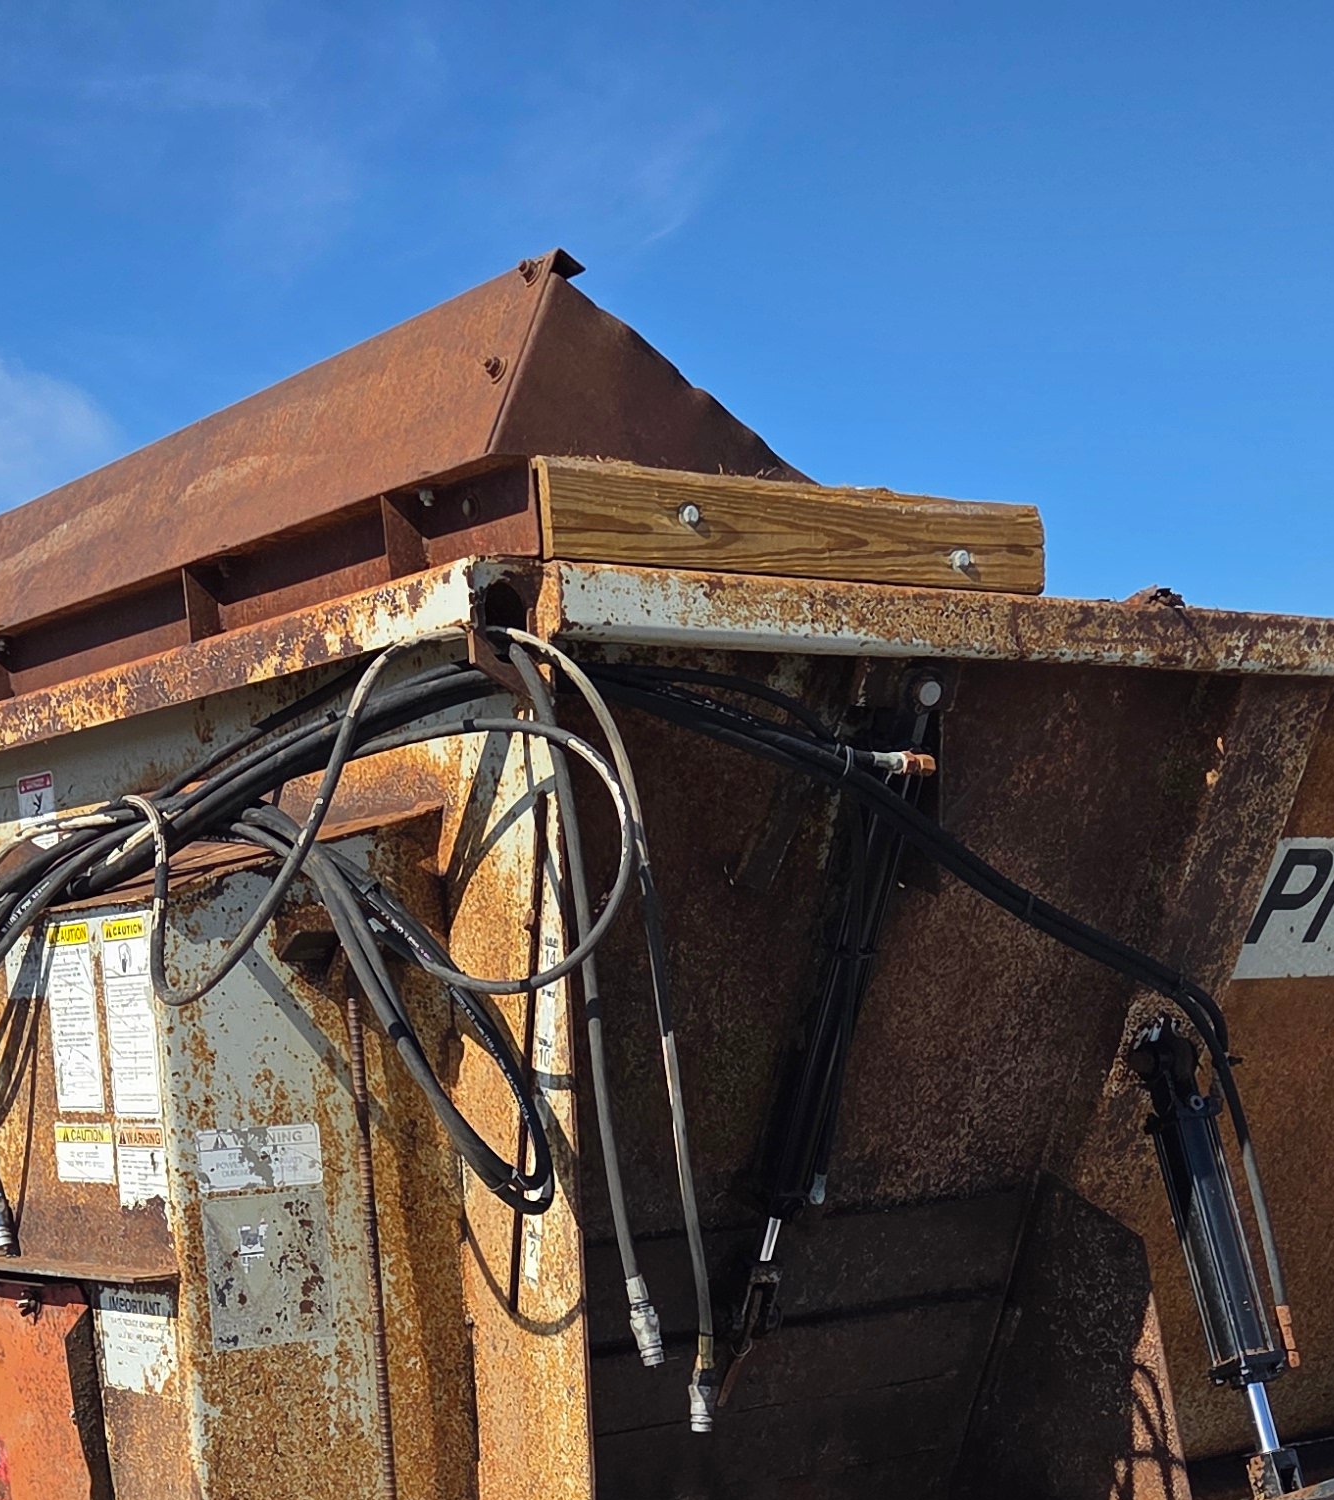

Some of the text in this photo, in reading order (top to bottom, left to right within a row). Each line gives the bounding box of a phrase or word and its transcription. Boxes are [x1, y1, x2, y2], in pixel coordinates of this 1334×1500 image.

[56, 926, 87, 942] CAUTION
[112, 923, 143, 937] CAUTION
[544, 948, 557, 968] 14
[539, 1047, 551, 1068] 10
[70, 1129, 104, 1142] CAUTION
[127, 1130, 161, 1145] WARNING
[108, 1295, 161, 1316] IMPORTANT
